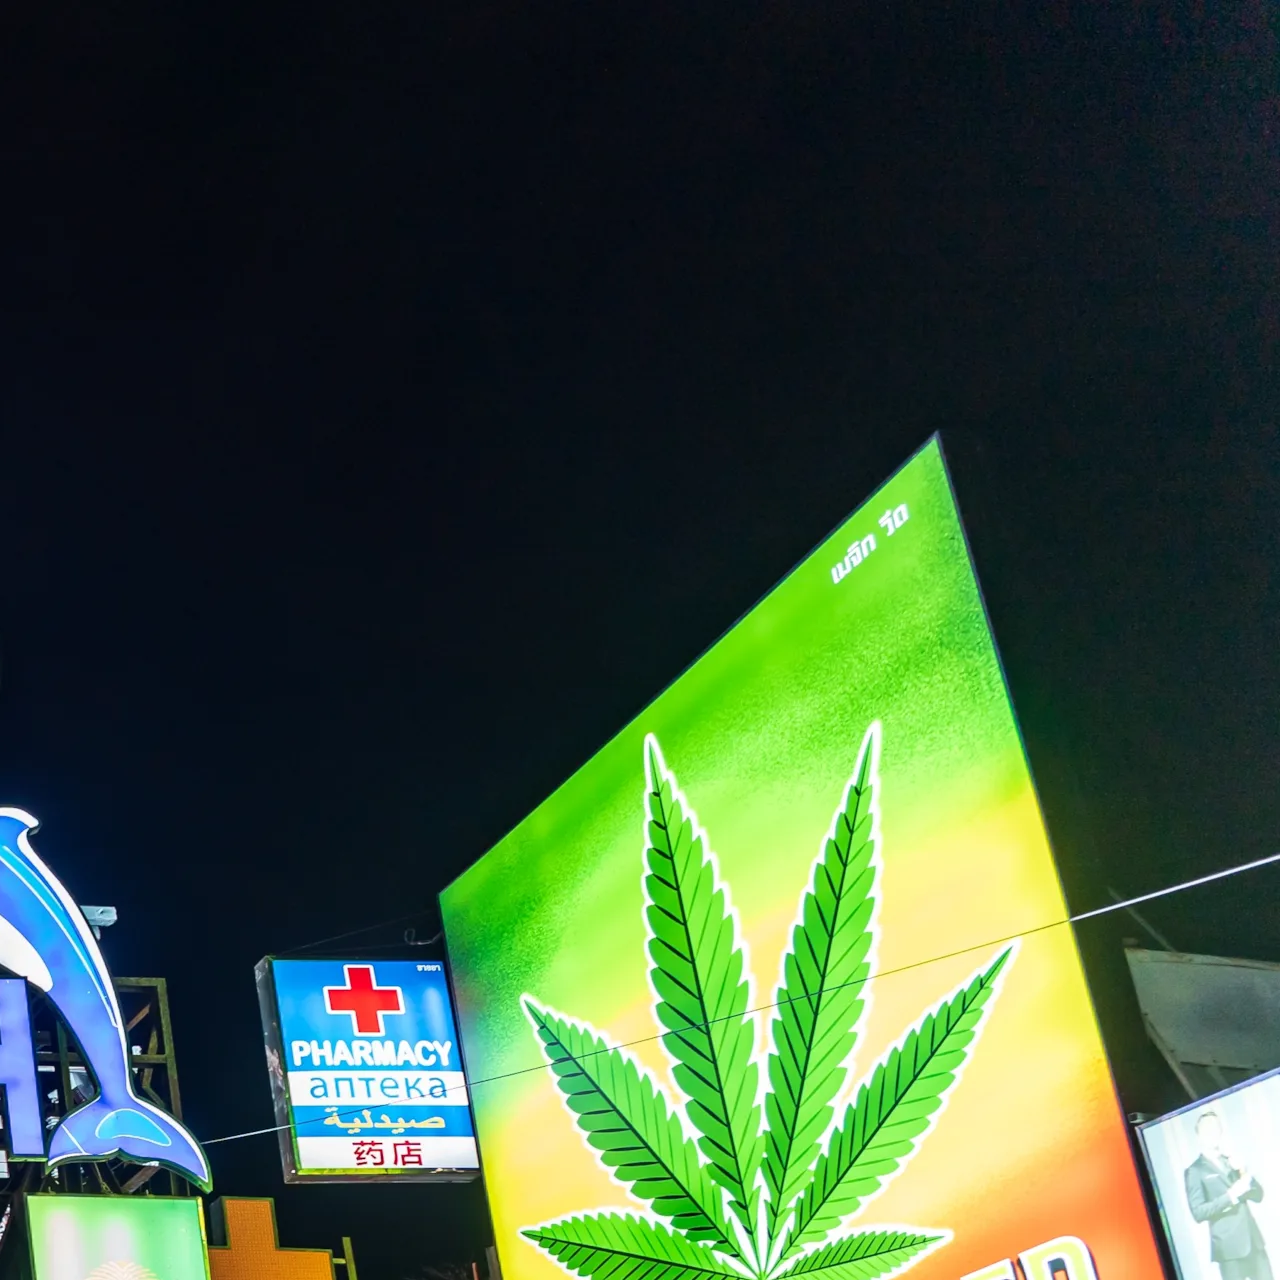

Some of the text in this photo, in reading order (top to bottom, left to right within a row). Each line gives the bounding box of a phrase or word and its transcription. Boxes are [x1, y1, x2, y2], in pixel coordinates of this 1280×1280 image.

[291, 1040, 452, 1066] PHARMACY
[310, 1076, 447, 1098] аптека
[323, 1105, 445, 1134] صيدلية
[352, 1140, 423, 1166] 药店
